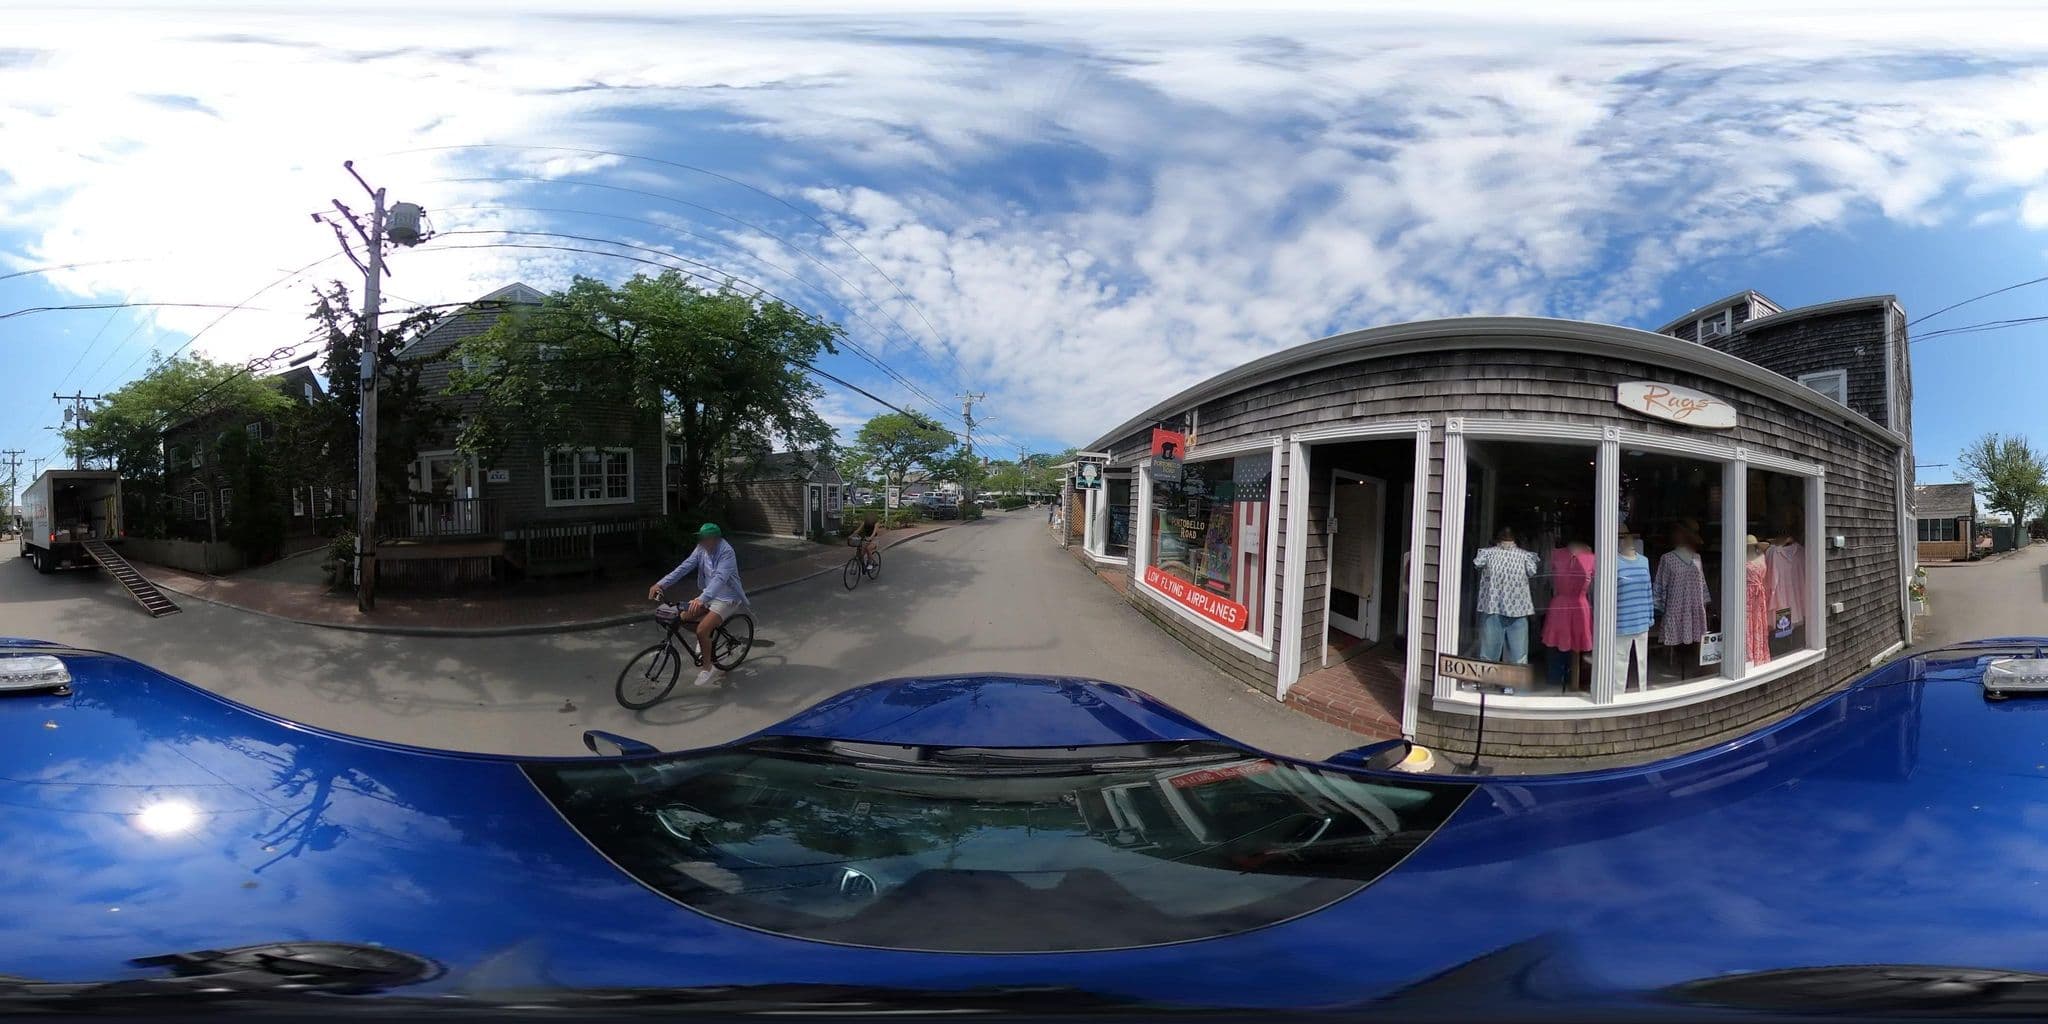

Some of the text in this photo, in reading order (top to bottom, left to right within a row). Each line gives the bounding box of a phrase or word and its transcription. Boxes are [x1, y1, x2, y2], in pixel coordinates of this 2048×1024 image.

[1643, 384, 1727, 420] Rags
[1180, 527, 1197, 539] ROAD
[1147, 569, 1237, 623] LOW FLYING AIRPLANES
